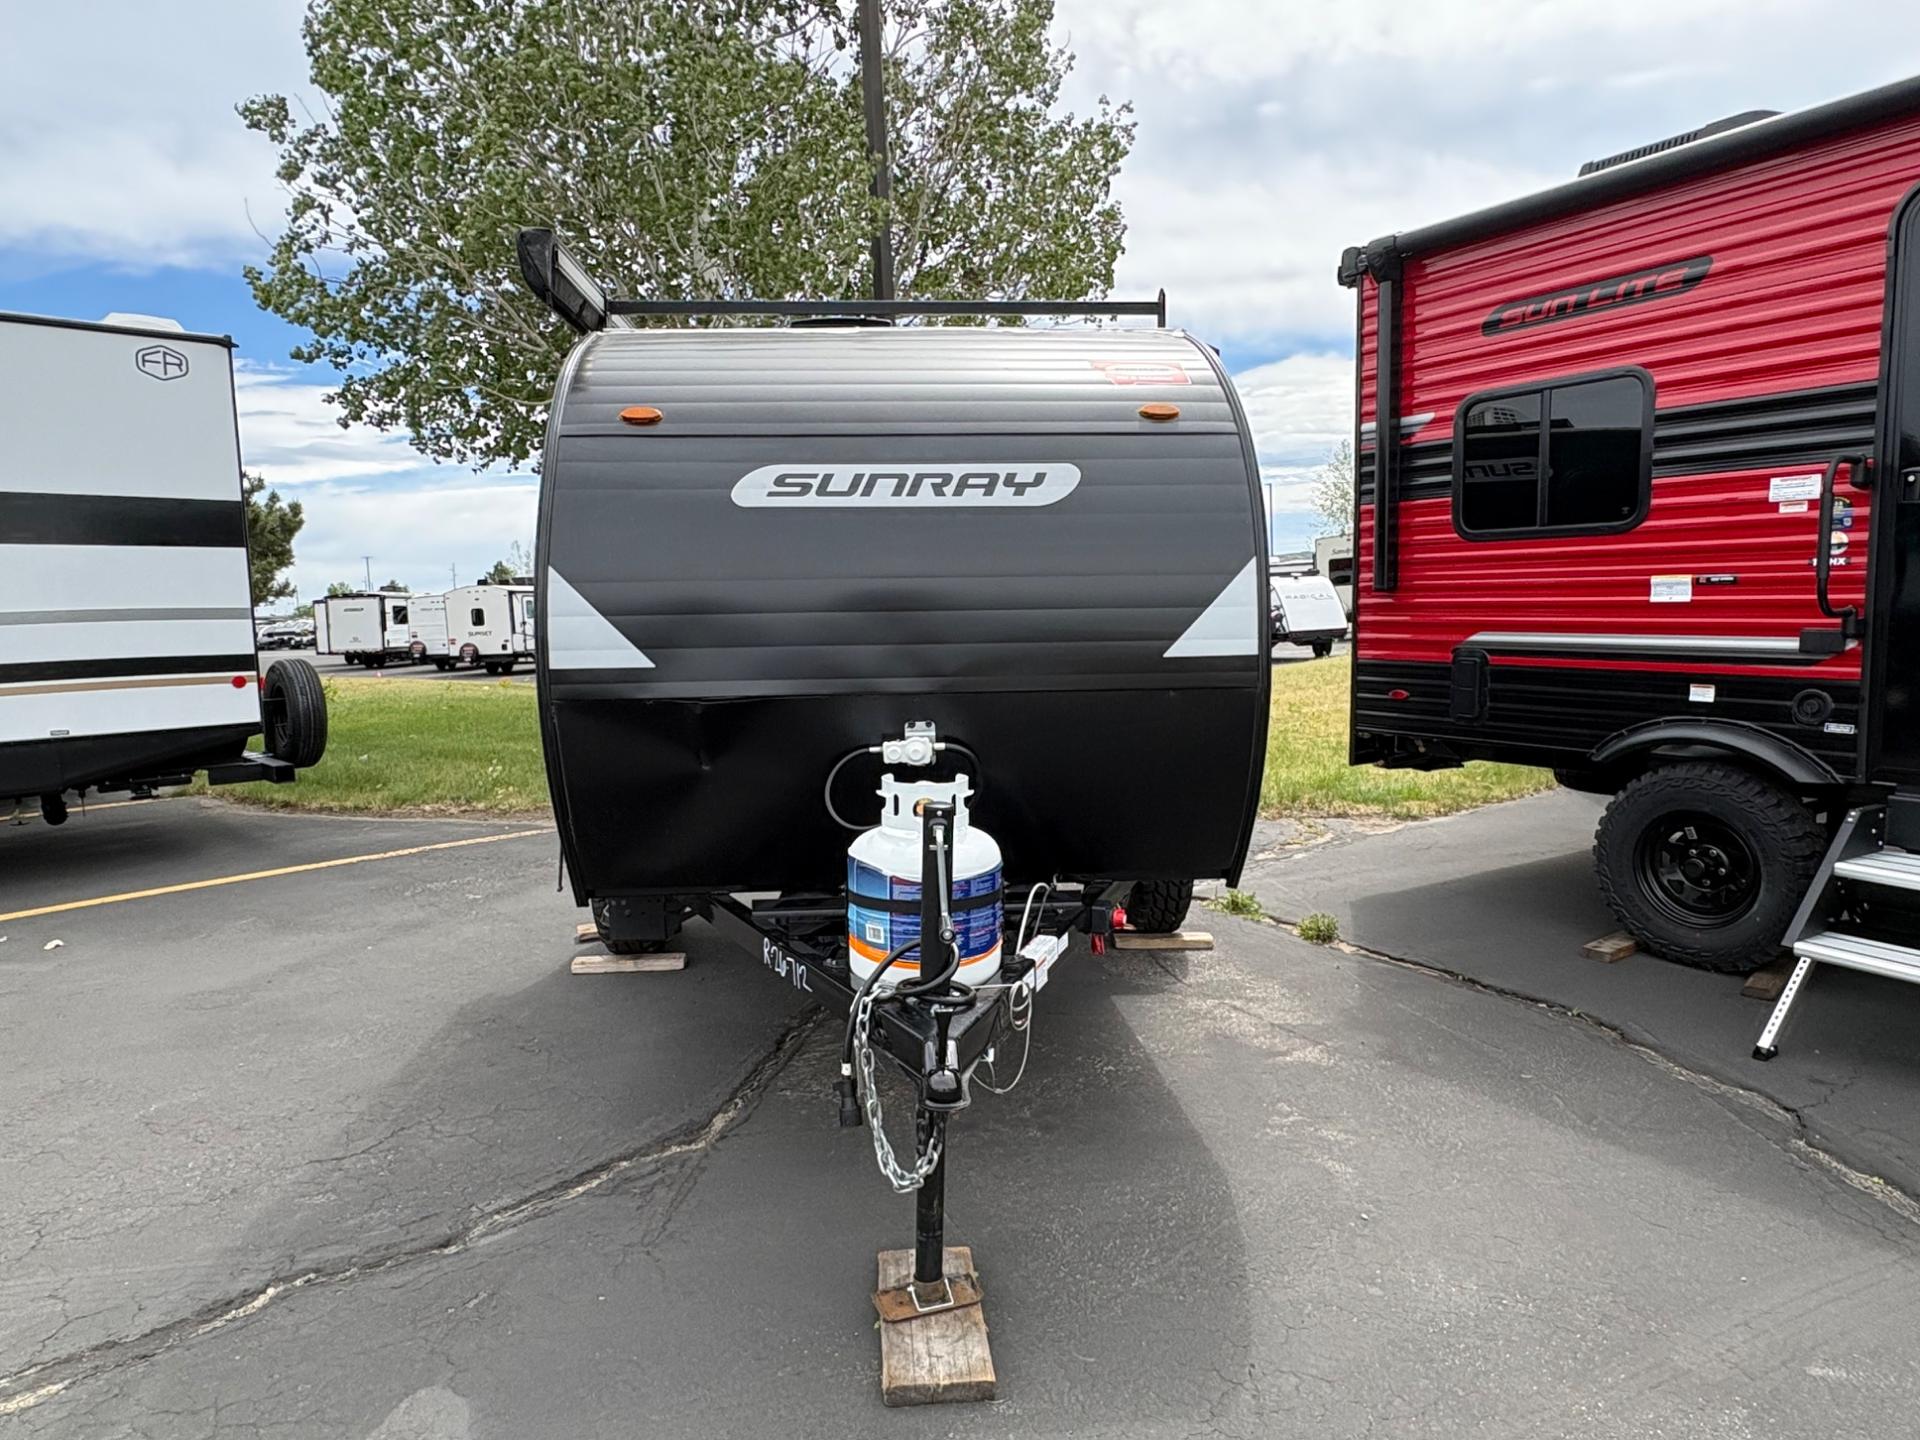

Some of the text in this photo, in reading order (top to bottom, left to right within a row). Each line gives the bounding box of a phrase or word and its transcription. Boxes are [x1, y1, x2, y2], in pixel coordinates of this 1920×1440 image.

[1500, 267, 1690, 328] SUN LITE
[141, 350, 183, 376] FR
[766, 472, 1048, 498] SUNRAY
